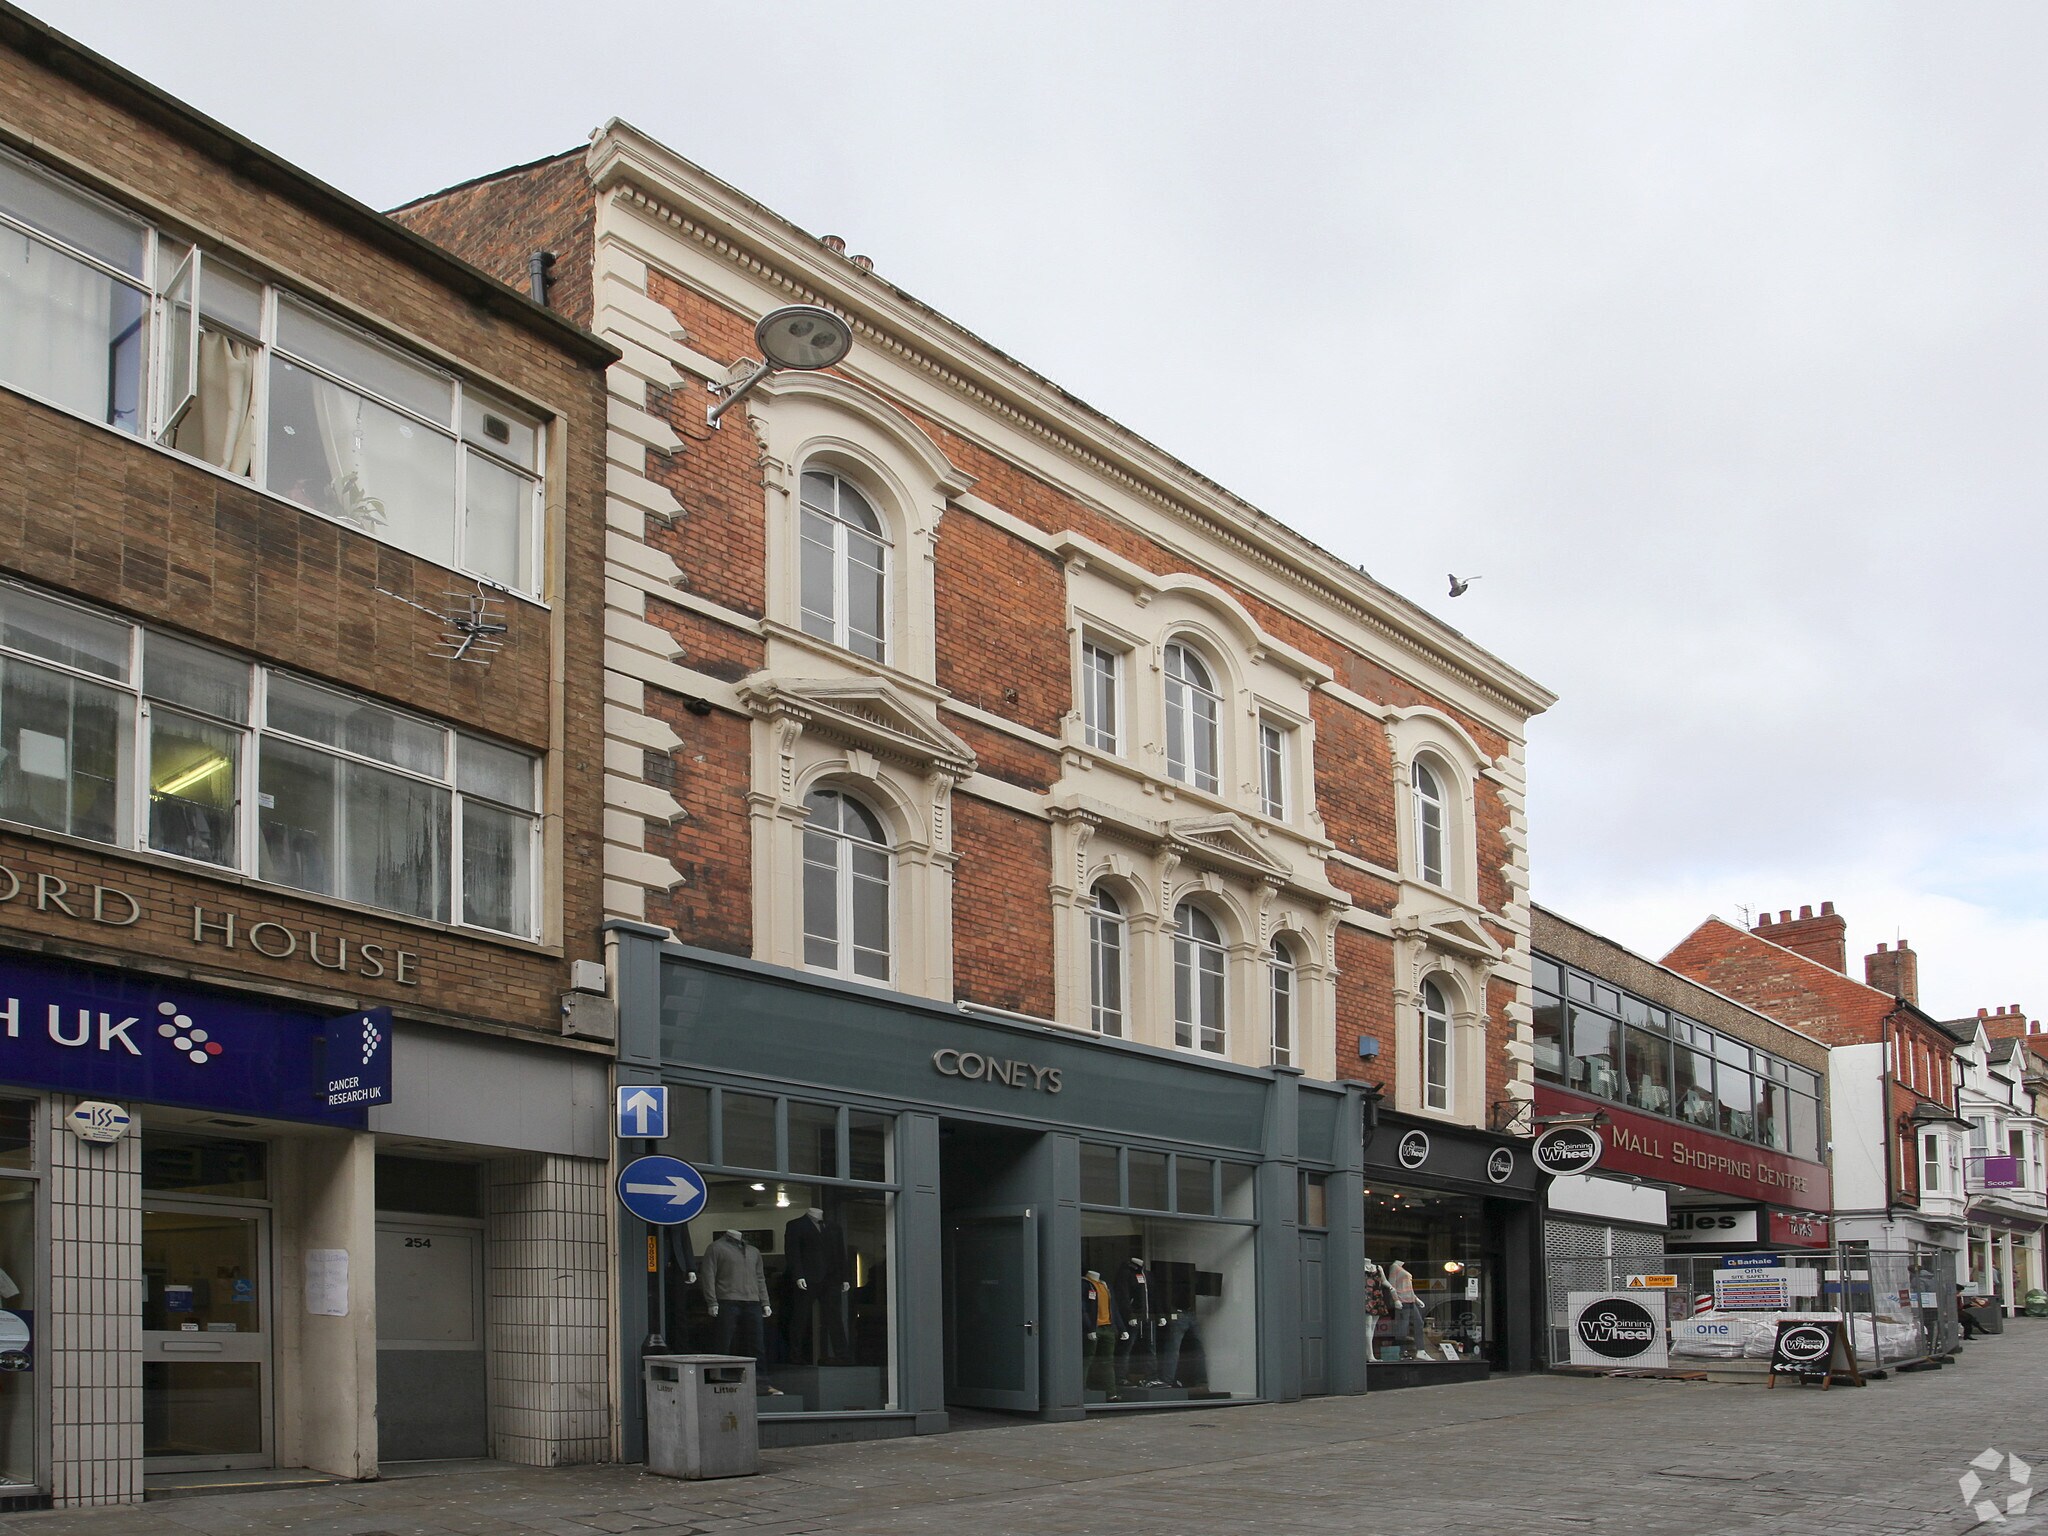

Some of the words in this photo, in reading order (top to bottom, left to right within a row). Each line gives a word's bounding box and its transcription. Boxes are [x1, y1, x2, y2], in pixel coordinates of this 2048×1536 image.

[193, 904, 417, 986] HOUSE
[48, 1003, 143, 1057] UK
[932, 1047, 1063, 1094] CONEYS
[329, 1076, 359, 1092] CANCER
[329, 1089, 369, 1106] RESEARCH
[369, 1086, 382, 1099] UK
[1540, 1146, 1593, 1161] Wheel
[1554, 1140, 1593, 1151] Spinning
[404, 1237, 433, 1249] 254
[1598, 1312, 1652, 1329] Spinning
[1580, 1321, 1652, 1341] Wheel
[1786, 1339, 1824, 1350] Wheel
[714, 1385, 738, 1394] Litter
